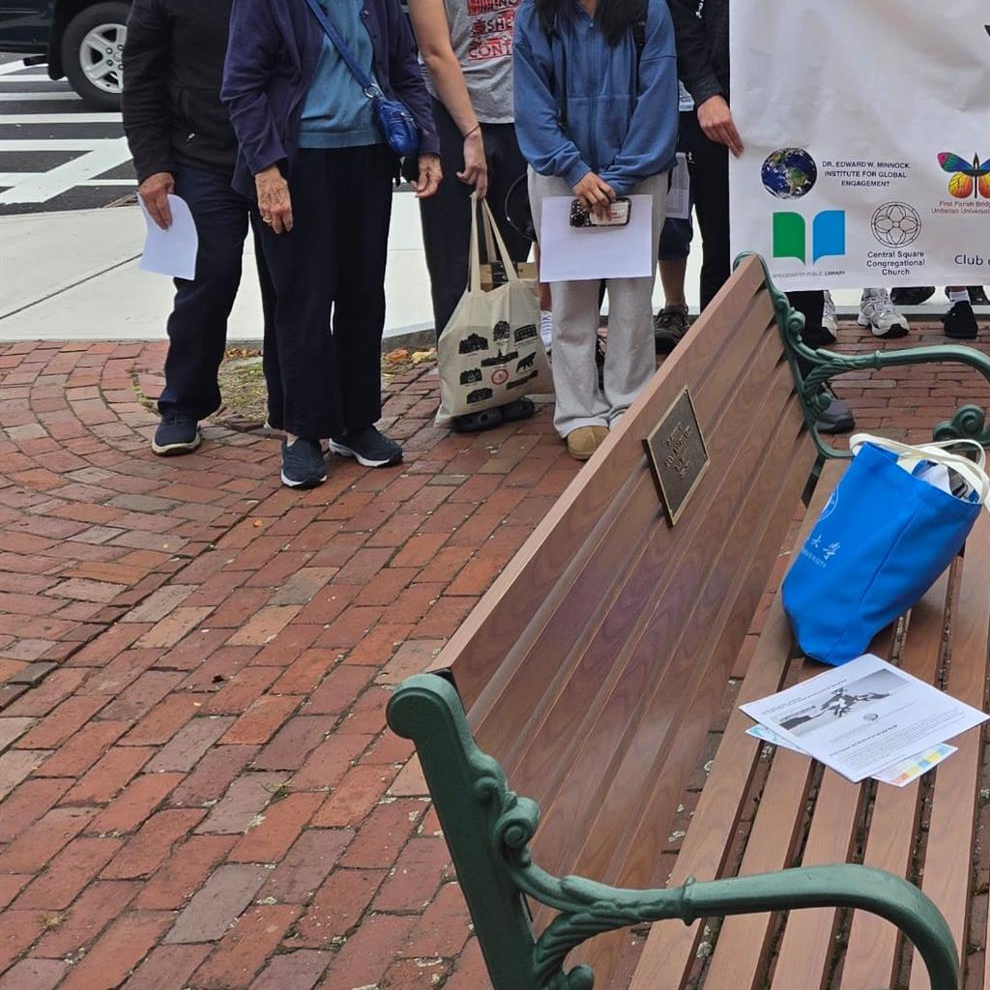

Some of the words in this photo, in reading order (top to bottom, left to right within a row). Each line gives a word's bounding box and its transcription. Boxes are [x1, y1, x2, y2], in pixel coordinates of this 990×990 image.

[867, 250, 895, 258] Central
[897, 250, 925, 259] Square
[866, 258, 926, 268] Congregational
[954, 254, 984, 266] Club
[881, 268, 910, 276] Church
